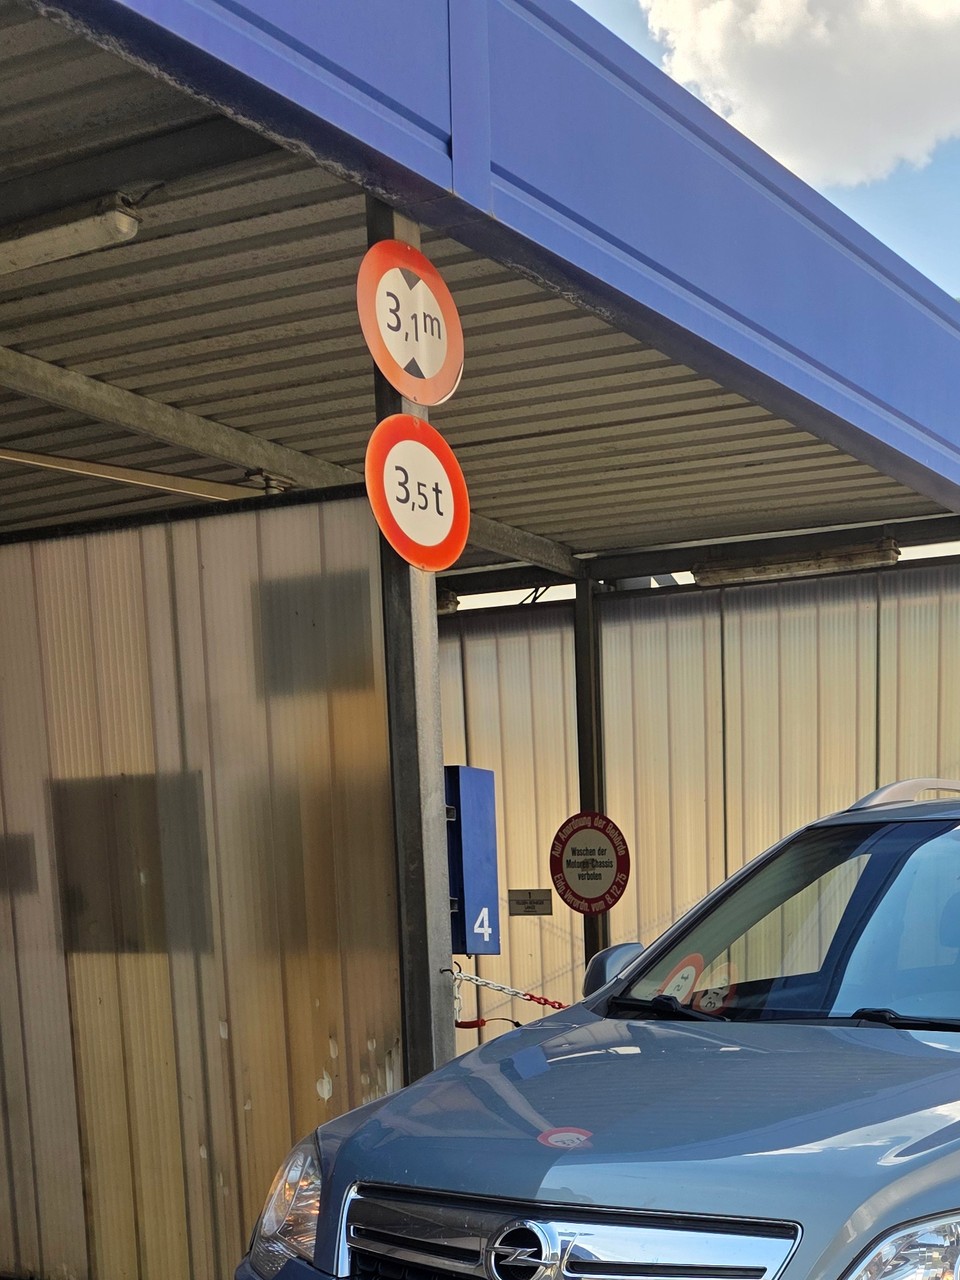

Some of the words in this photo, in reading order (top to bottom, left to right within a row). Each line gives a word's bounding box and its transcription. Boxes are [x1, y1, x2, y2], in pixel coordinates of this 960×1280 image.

[552, 840, 562, 858] Auf
[594, 816, 607, 829] der
[571, 846, 596, 856] Waschen
[598, 846, 607, 856] der
[566, 858, 614, 869] Motoren-Chassis
[578, 872, 602, 880] verboten
[474, 907, 492, 941] 4
